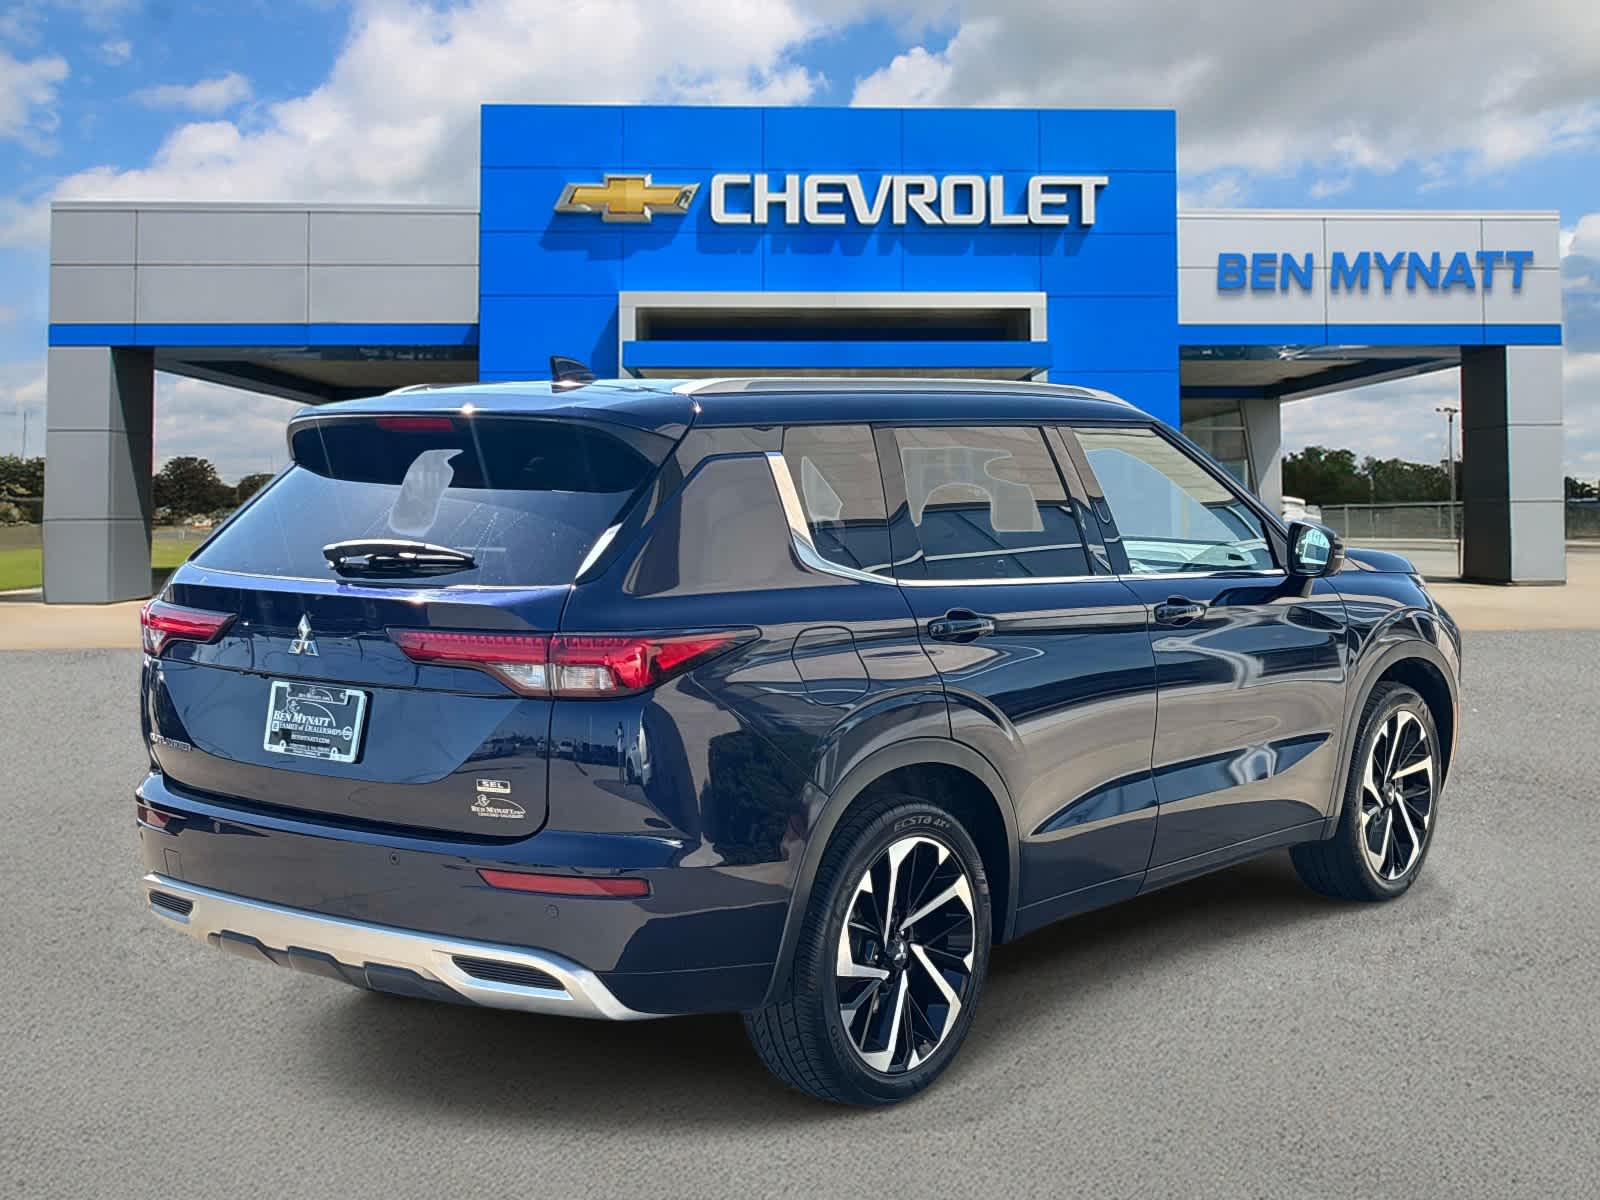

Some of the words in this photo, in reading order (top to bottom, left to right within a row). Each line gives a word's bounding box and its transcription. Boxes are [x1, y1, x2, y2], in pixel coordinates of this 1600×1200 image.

[710, 173, 1109, 225] CHEVROLET
[1216, 252, 1313, 291] BEN
[1330, 250, 1534, 291] MYNATT
[273, 710, 292, 722] BEN
[292, 712, 331, 726] MYNATT
